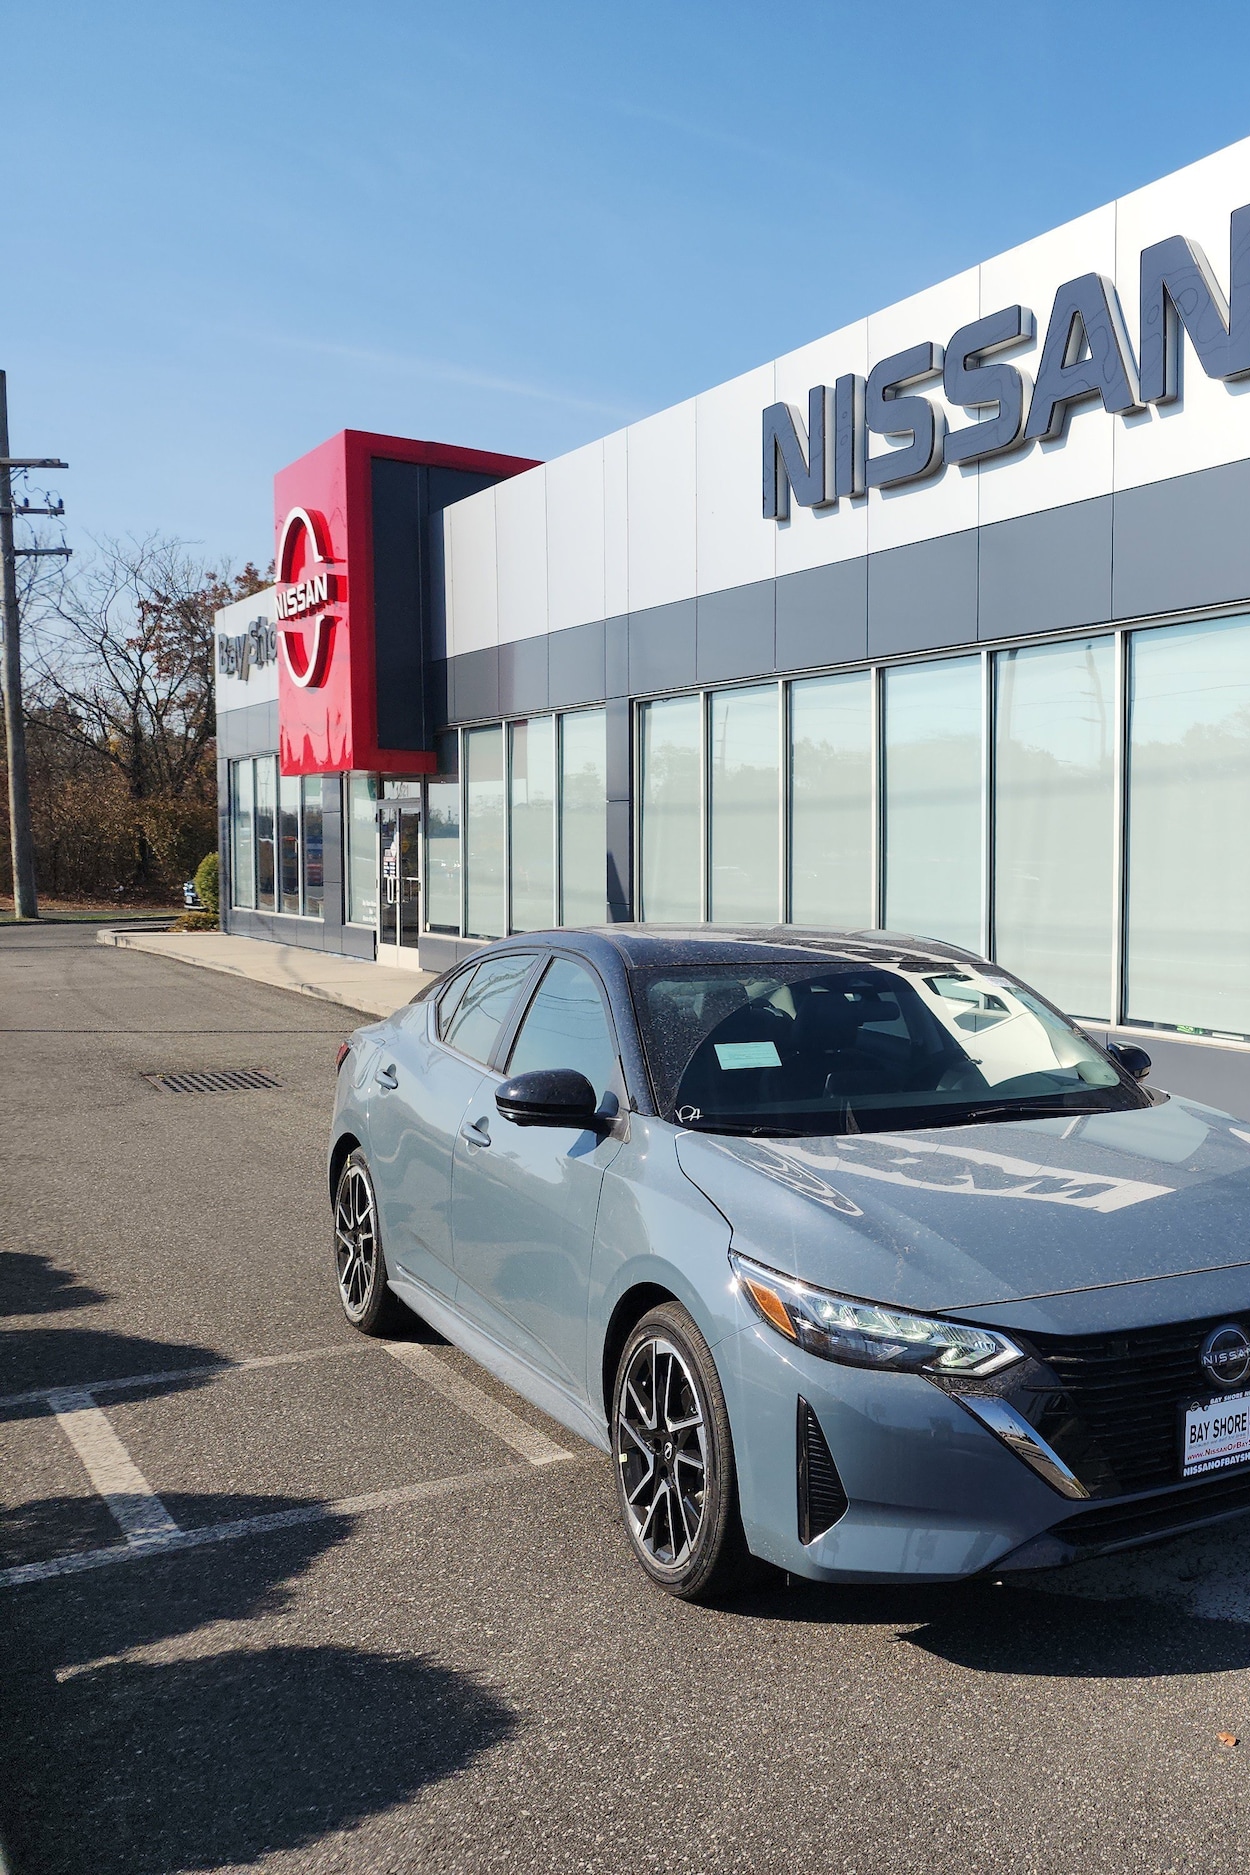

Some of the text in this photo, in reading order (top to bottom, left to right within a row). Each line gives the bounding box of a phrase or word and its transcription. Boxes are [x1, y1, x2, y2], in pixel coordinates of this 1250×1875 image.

[275, 573, 328, 620] NISSAN
[218, 616, 278, 681] Bay Sho
[1210, 1397, 1223, 1405] BAY
[1223, 1391, 1243, 1402] SHORE
[1189, 1421, 1210, 1444] BAY
[1213, 1412, 1247, 1439] SHORE
